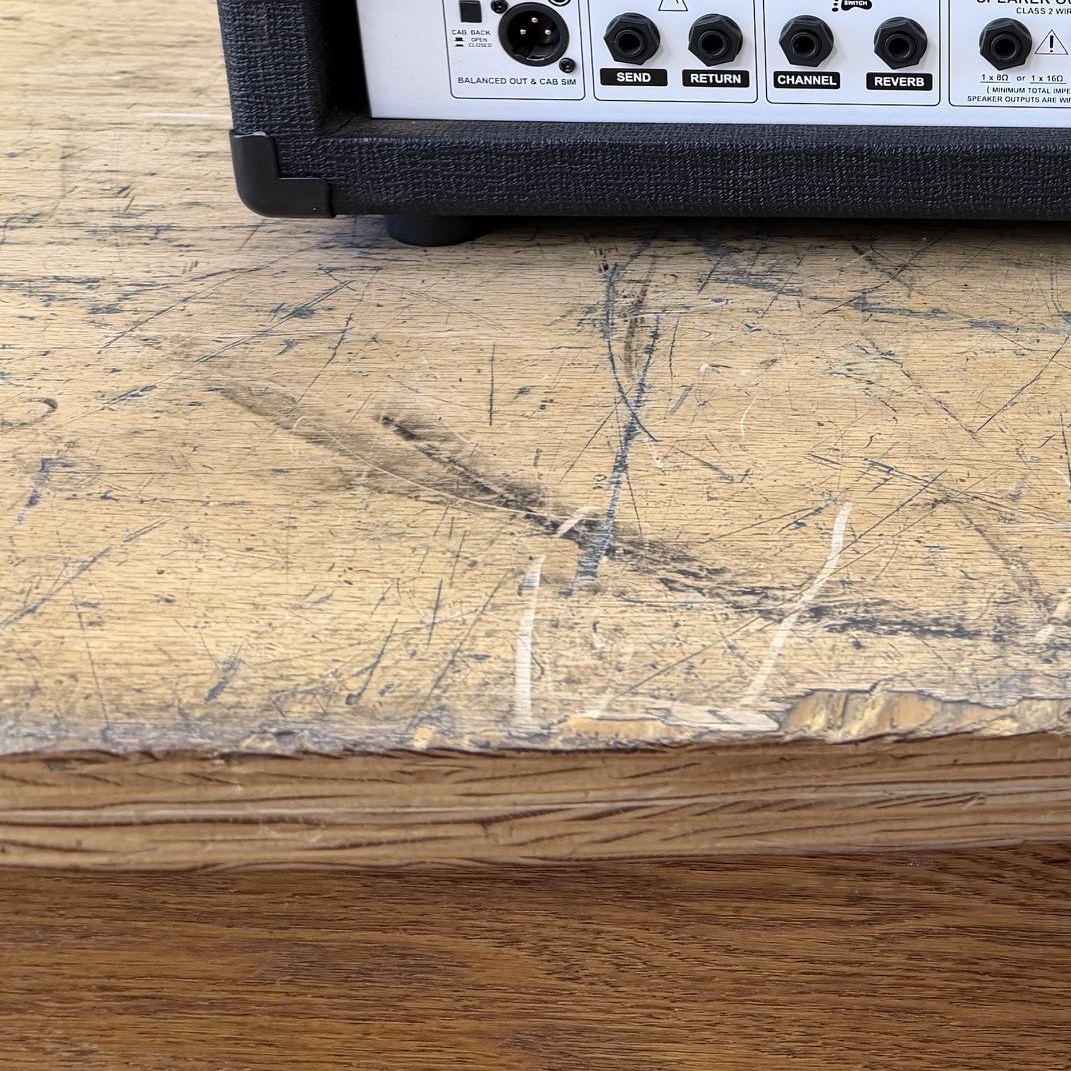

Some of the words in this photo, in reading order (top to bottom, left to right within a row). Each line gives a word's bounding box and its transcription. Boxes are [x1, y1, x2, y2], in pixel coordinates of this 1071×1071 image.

[1016, 7, 1046, 15] CLASS
[1048, 7, 1053, 15] 2
[458, 77, 507, 85] BALANCED
[616, 72, 651, 82] SEND
[690, 73, 742, 84] RETURN
[777, 74, 837, 86] CHANNEL
[874, 76, 925, 87] REVERB
